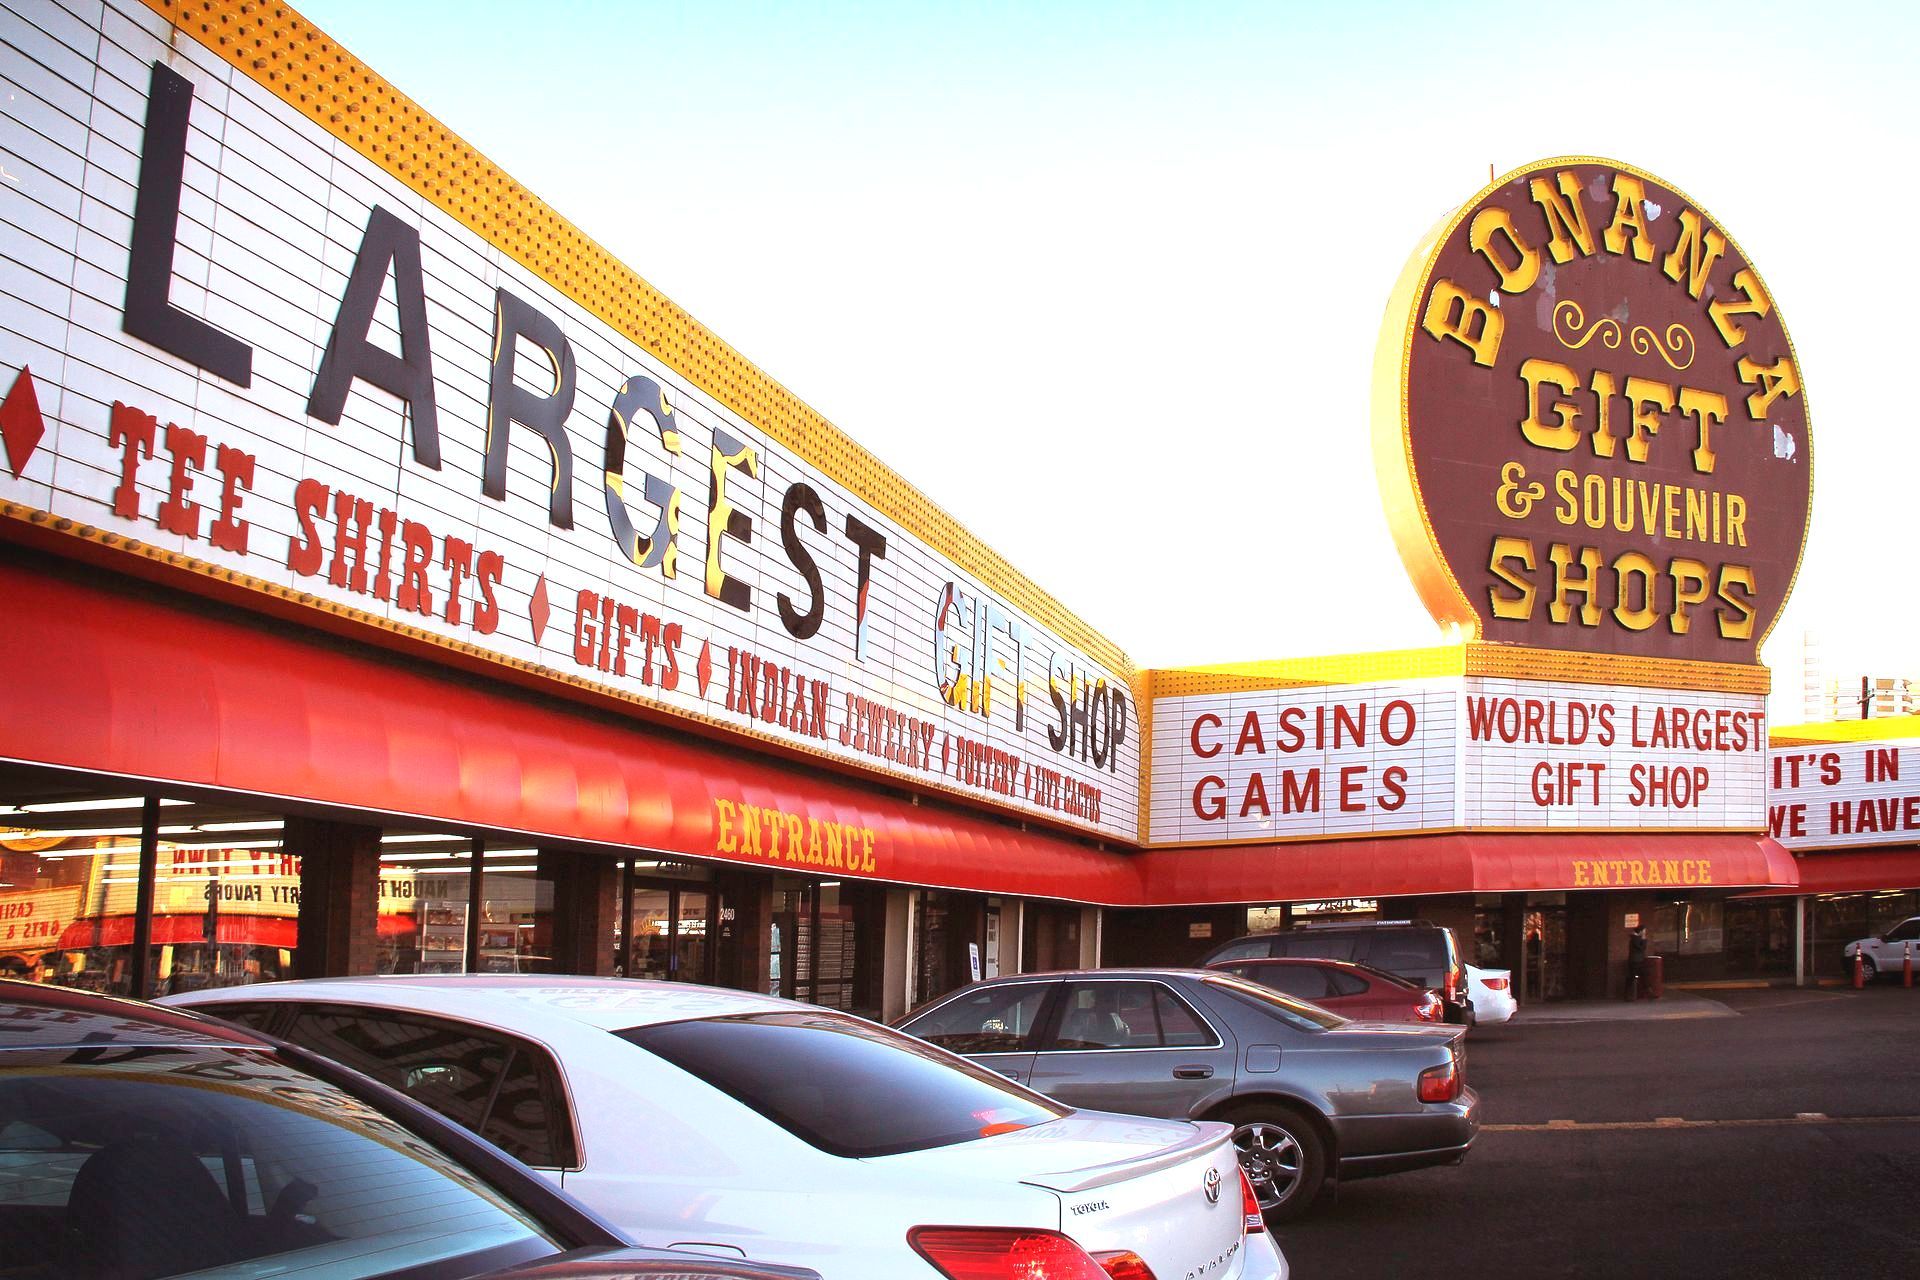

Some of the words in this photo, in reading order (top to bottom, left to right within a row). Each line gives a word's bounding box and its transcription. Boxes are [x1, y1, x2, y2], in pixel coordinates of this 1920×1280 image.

[1421, 168, 1801, 420] BONANZA
[122, 60, 886, 663] LARGEST
[935, 581, 1033, 732] GIFT
[1047, 651, 1126, 773] SHOP
[1519, 357, 1730, 473] GIFT
[1495, 461, 1545, 519] &
[1555, 469, 1747, 547] SOUVENIR
[109, 400, 255, 556] TEE
[287, 478, 504, 635] SHIRTS
[574, 589, 682, 691] GIFTS
[725, 645, 828, 740] INDIAN
[840, 692, 935, 771] JEWELRY
[956, 735, 1020, 797] POTTERY
[1034, 765, 1061, 811] LIVE
[1064, 775, 1102, 824] CACTUS
[1488, 535, 1757, 640] SHOPS
[1190, 699, 1416, 759] CASINO
[1466, 695, 1616, 747] WORLD'S
[1632, 705, 1765, 752] LARGEST
[1192, 765, 1408, 821] GAMES
[1531, 761, 1606, 806] GIFT
[1628, 763, 1710, 809] SHOP
[1773, 752, 1842, 789] IT'S
[1865, 748, 1899, 782] IN
[714, 797, 876, 872] ENTRANCE
[1768, 804, 1807, 838] WE
[1830, 796, 1920, 834] HAVE
[1572, 859, 1712, 886] ENTRANCE
[720, 908, 735, 920] 2460
[1070, 1200, 1110, 1215] TOYOTA
